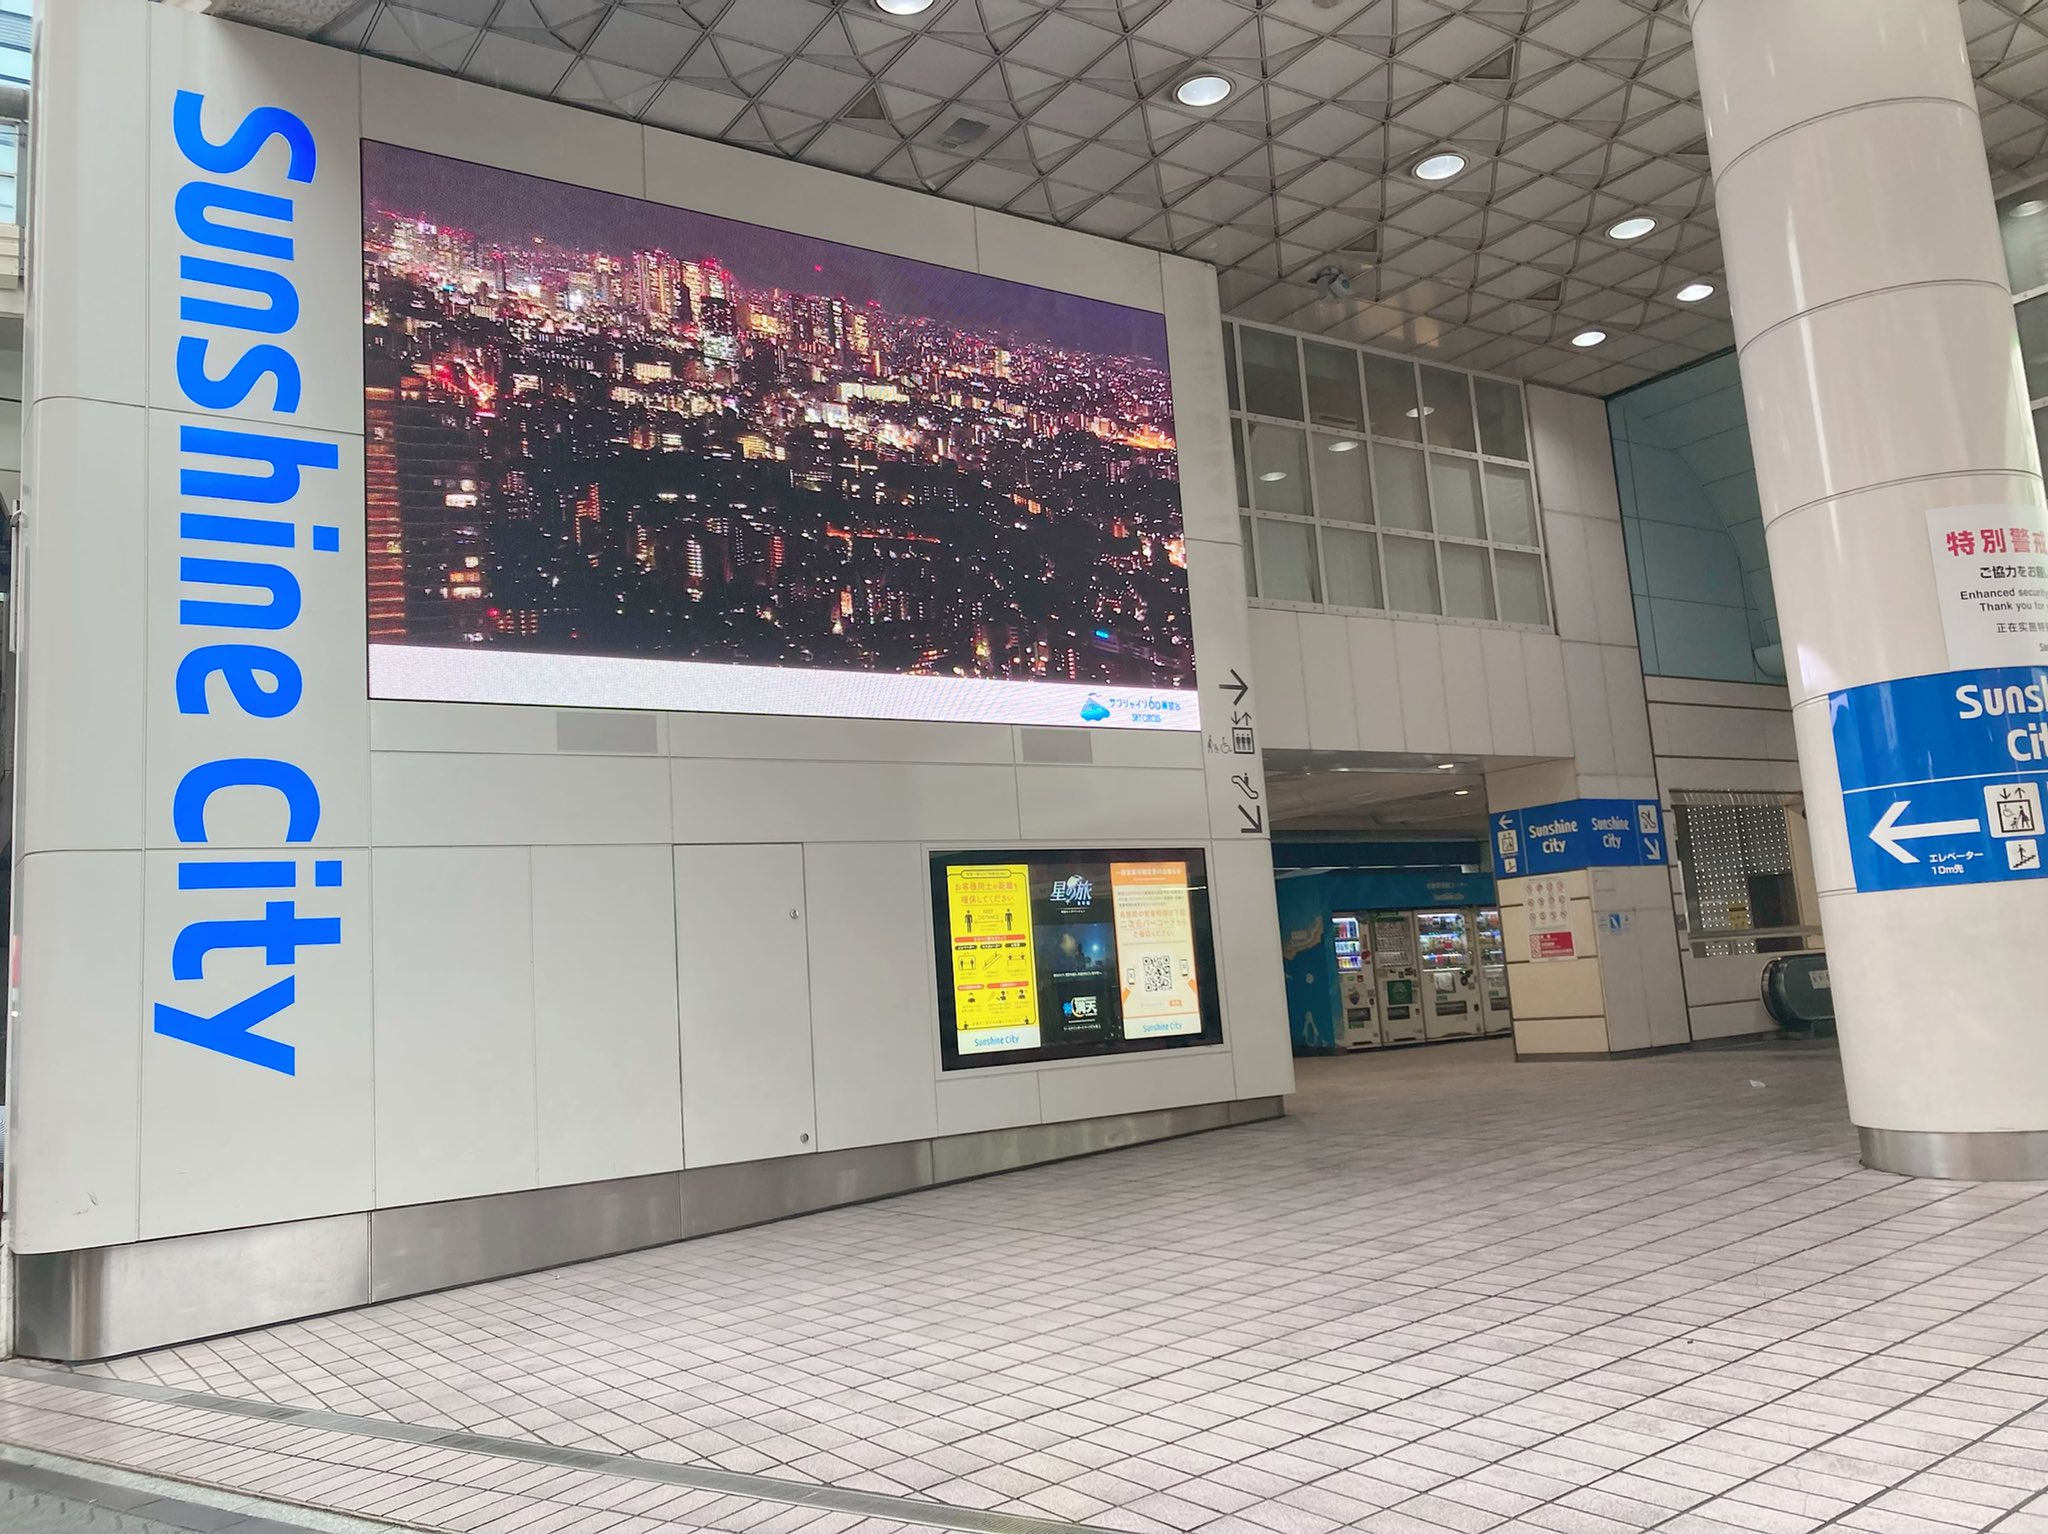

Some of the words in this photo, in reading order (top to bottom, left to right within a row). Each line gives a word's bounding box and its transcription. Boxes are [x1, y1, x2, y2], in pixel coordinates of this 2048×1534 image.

[173, 88, 340, 719] Sunshine
[1979, 565, 2048, 579] ご協力をお願
[1960, 588, 2015, 600] Enhanced
[1979, 601, 2013, 612] Thank
[2015, 601, 2032, 612] you
[1528, 818, 1579, 839] Sunshine
[1591, 816, 1630, 831] Sunshine
[1542, 838, 1566, 854] City
[1602, 833, 1622, 849] City
[1929, 850, 1984, 863] エレベーター
[1931, 864, 1965, 876] 10m先
[153, 757, 343, 1077] City
[974, 1036, 1004, 1048] Sunshine
[1005, 1033, 1020, 1045] City
